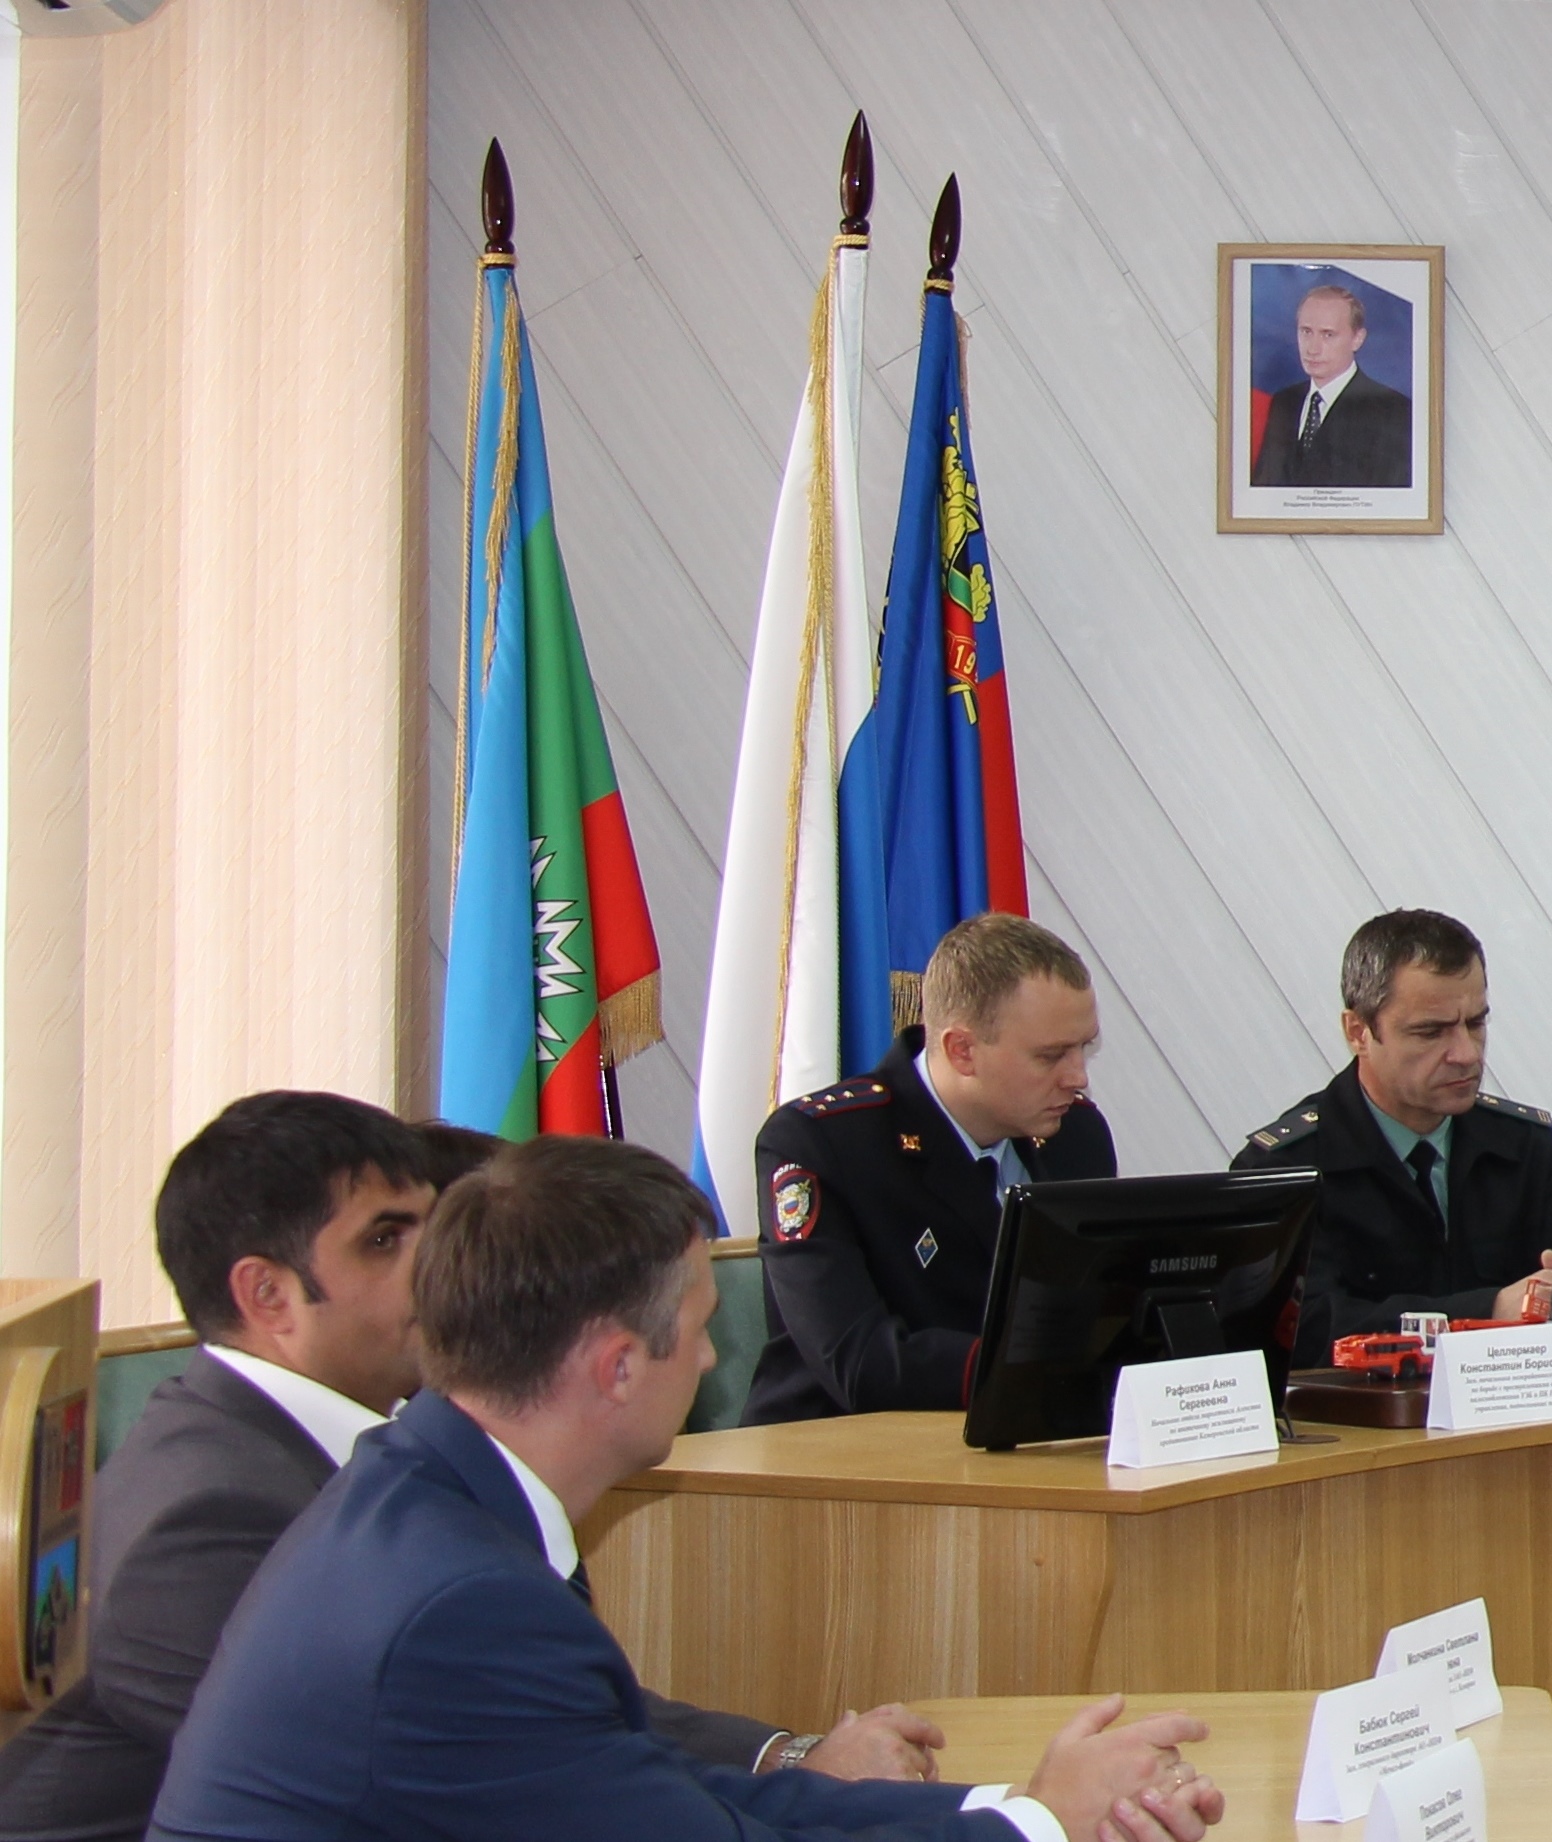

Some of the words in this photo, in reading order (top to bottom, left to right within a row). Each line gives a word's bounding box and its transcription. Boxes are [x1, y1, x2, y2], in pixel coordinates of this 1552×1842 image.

[1150, 1255, 1218, 1273] SAMSUNG
[1488, 1345, 1547, 1359] Целлермаер
[1460, 1361, 1522, 1375] Константин
[1165, 1382, 1210, 1398] Рафикова
[1212, 1377, 1237, 1390] Анна
[1179, 1394, 1228, 1412] Сергеевна
[1359, 1717, 1388, 1734] Бабюк
[1390, 1704, 1420, 1725] Сергей
[1354, 1724, 1430, 1756] Константинович
